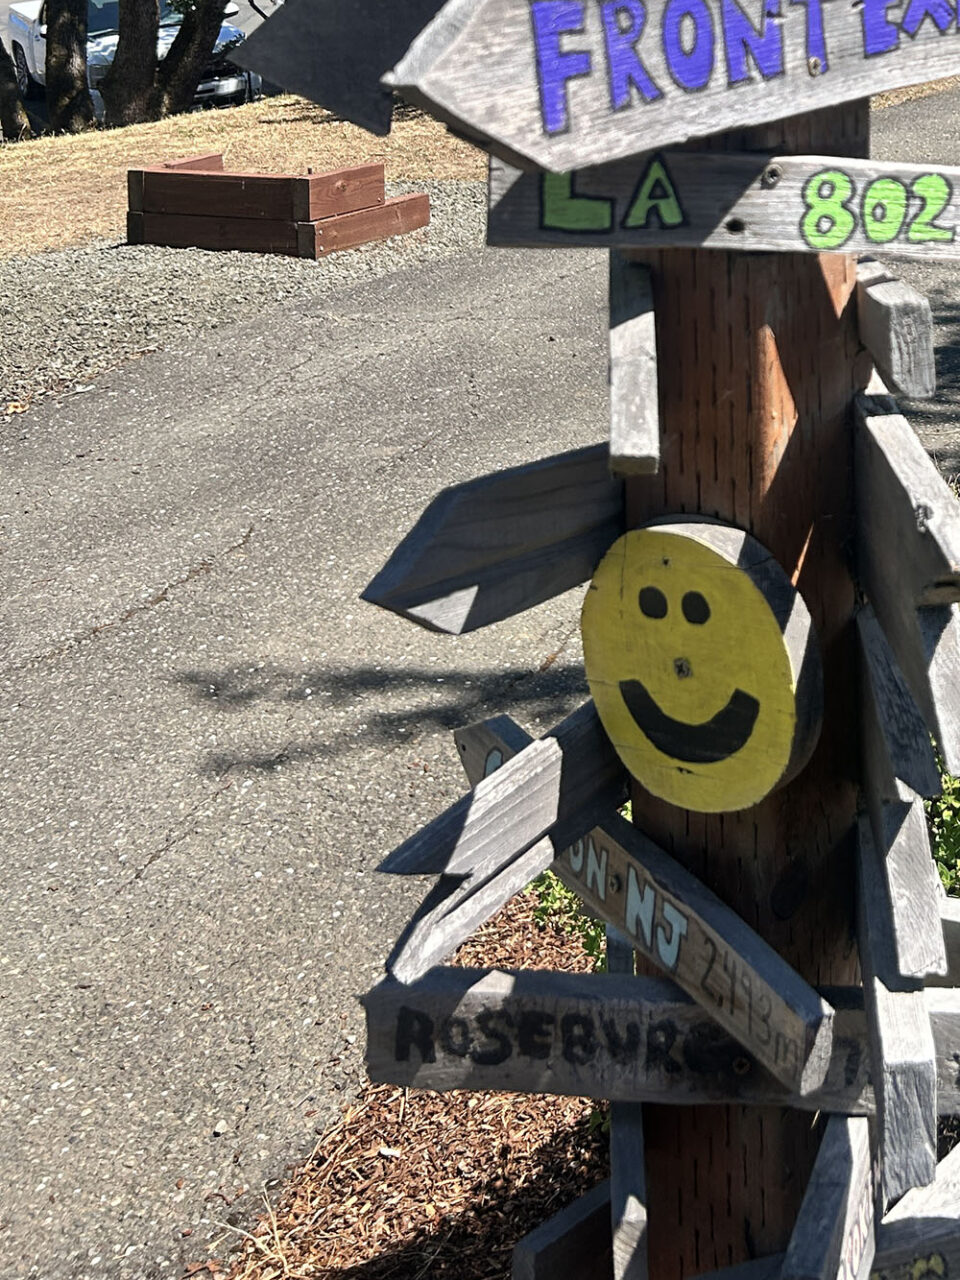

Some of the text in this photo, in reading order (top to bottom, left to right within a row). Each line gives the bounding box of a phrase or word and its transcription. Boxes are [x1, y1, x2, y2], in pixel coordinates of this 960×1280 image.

[538, 153, 686, 234] LA
[800, 166, 956, 250] 802
[625, 862, 689, 977] NJ
